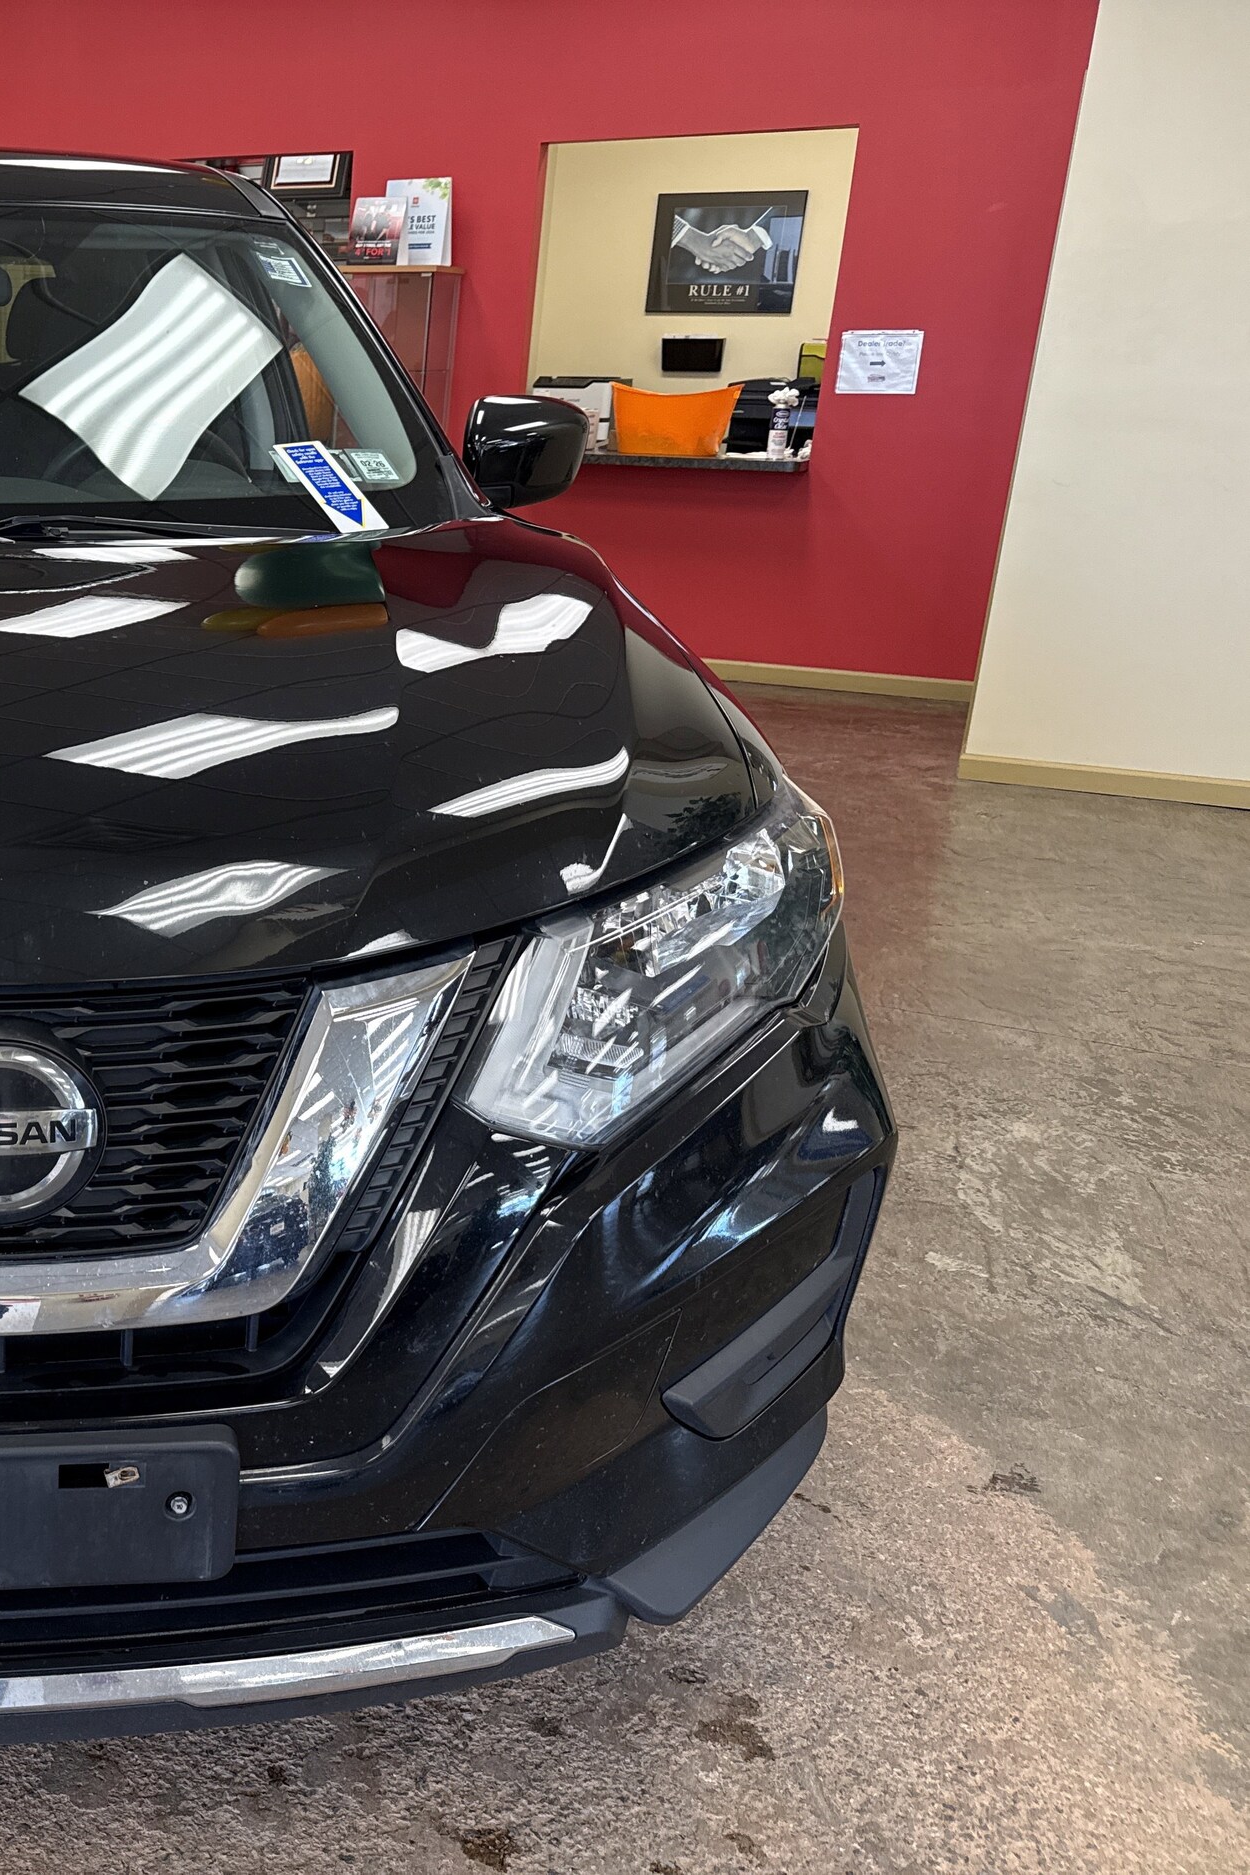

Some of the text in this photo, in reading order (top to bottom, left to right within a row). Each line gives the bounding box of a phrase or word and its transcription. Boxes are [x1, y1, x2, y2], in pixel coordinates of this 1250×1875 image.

[416, 215, 436, 223] BEST
[365, 248, 384, 256] FOR
[688, 284, 750, 297] RULE #1
